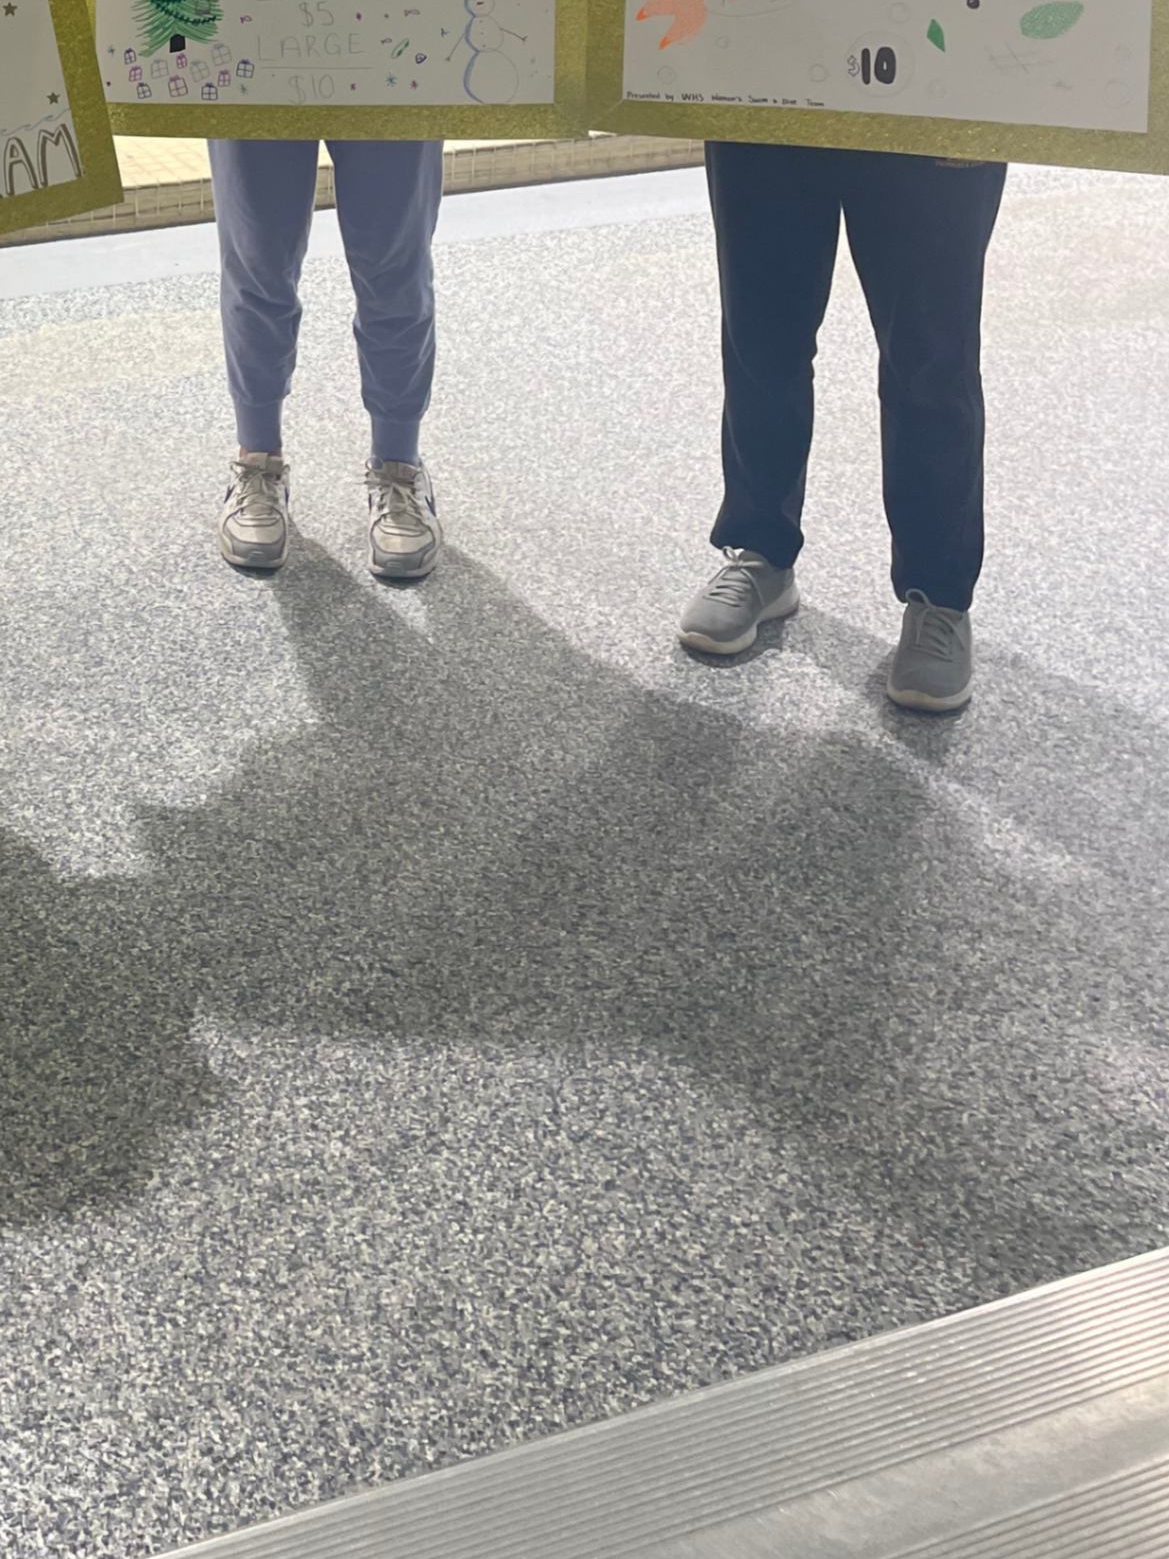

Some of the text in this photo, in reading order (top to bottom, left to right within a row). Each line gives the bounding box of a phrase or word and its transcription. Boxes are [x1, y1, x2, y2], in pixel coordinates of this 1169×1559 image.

[298, 0, 334, 27] $5
[257, 32, 365, 62] LARGE
[288, 74, 335, 105] $10
[665, 93, 674, 101] by
[681, 93, 704, 101] WHS
